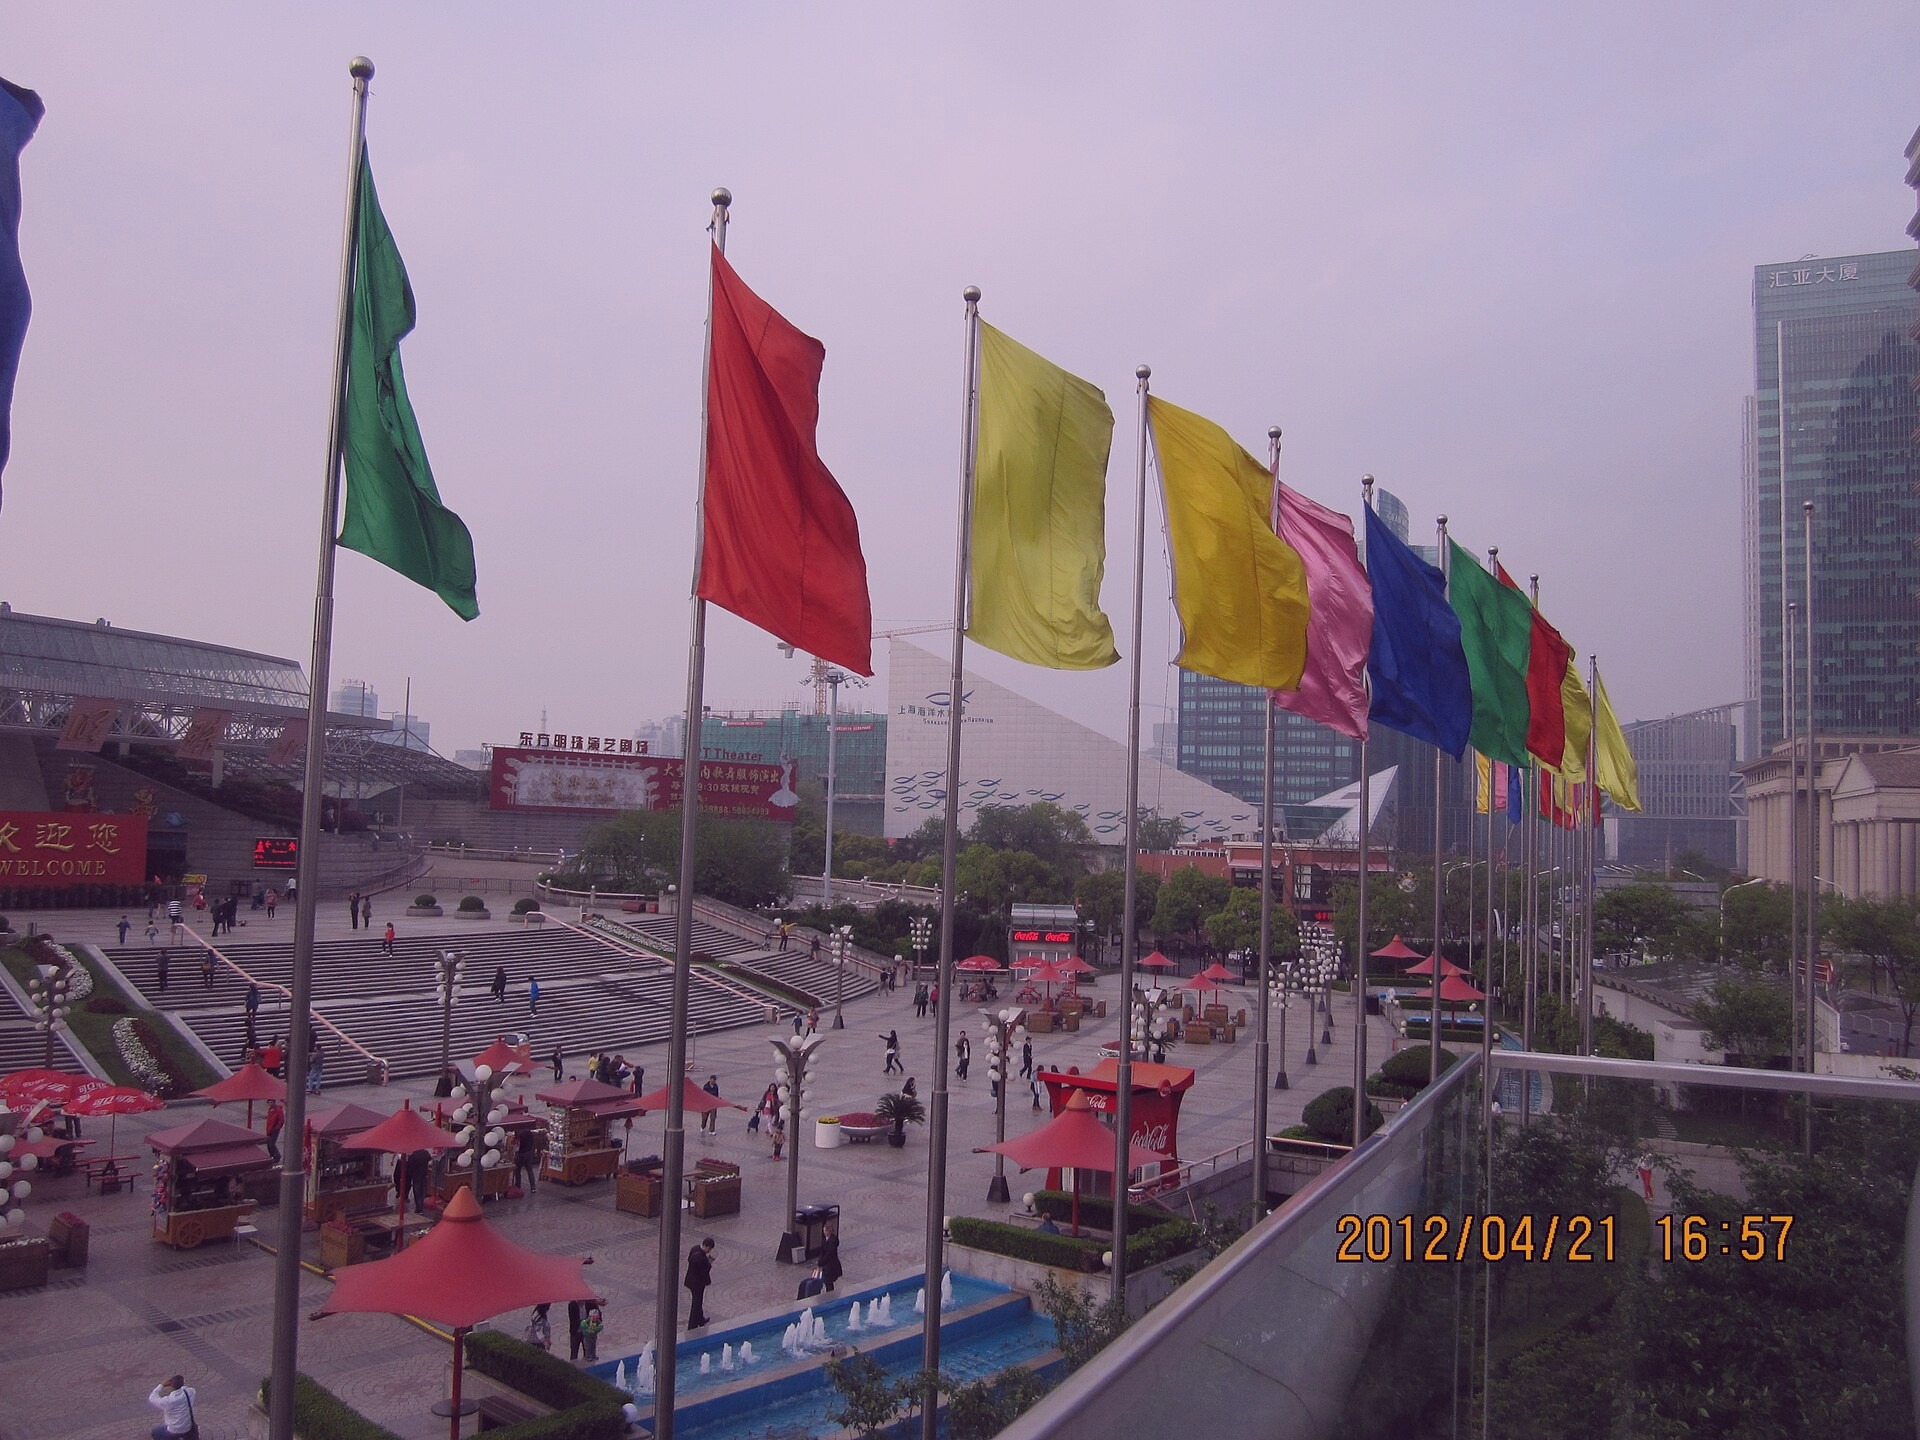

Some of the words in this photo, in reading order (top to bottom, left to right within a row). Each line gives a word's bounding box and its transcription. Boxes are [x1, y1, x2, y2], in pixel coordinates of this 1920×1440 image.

[1769, 263, 1859, 288] 汇亚大厦
[898, 705, 966, 717] 上海海洋水
[519, 731, 649, 754] 东方明珠演艺剧场
[714, 748, 763, 761] Theater
[662, 763, 779, 784] 大型内歌舞服饰演出
